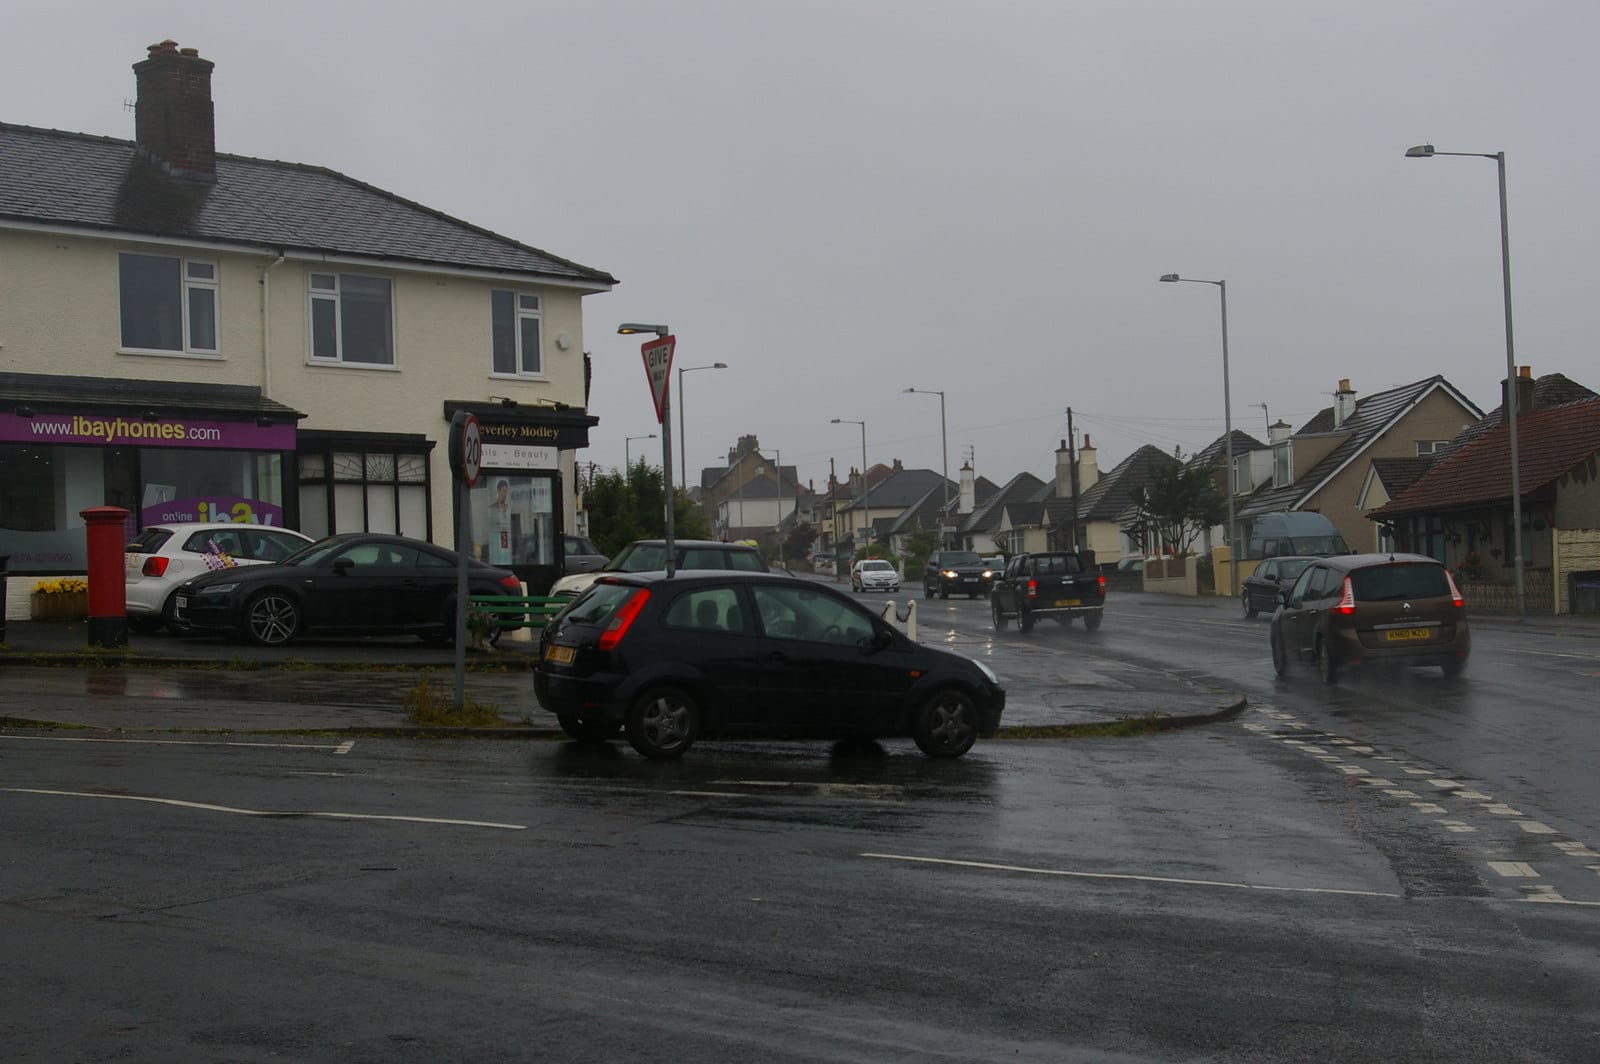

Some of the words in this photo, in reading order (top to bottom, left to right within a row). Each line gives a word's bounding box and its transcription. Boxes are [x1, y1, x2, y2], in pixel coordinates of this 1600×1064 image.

[648, 346, 668, 368] GIVE
[30, 416, 221, 442] www.ibayhomes.com
[479, 424, 519, 439] everley
[520, 426, 560, 440] Modley
[466, 437, 479, 466] 20
[480, 448, 497, 457] ils
[514, 449, 549, 460] Beauty
[162, 512, 193, 521] online
